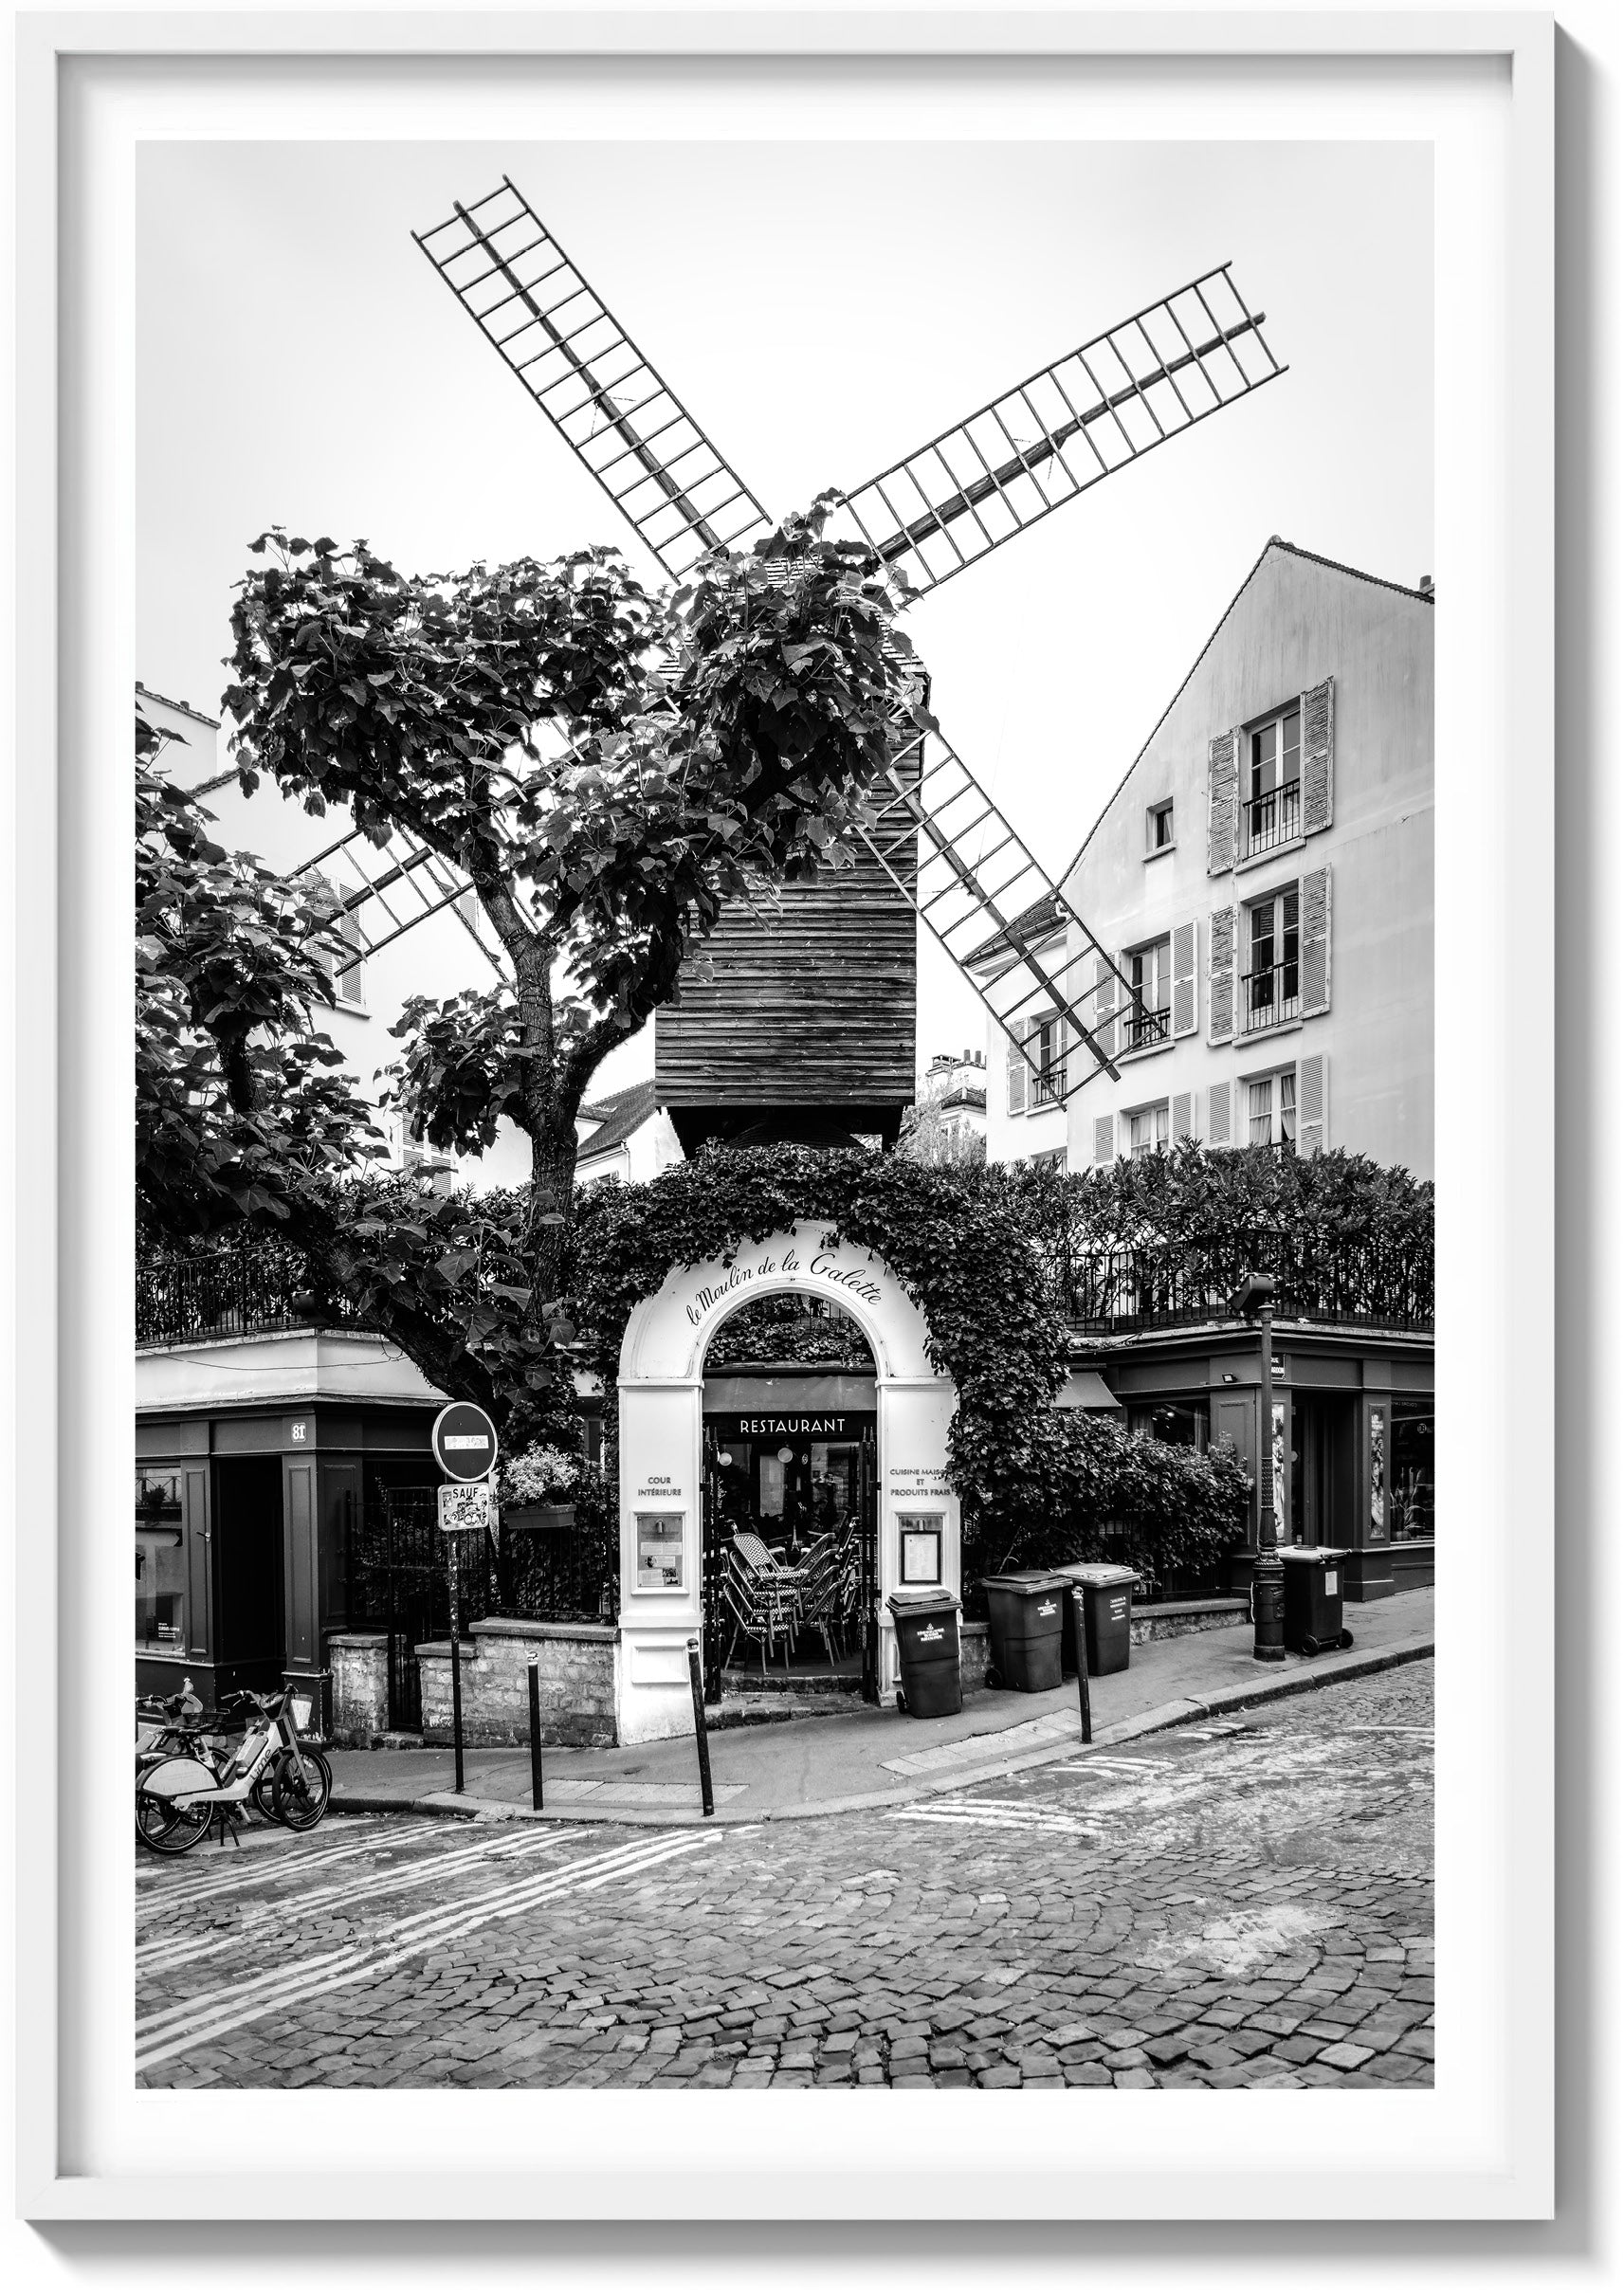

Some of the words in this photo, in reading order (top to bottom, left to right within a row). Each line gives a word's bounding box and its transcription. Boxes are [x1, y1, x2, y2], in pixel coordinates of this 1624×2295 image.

[686, 1304, 702, 1326] le
[696, 1266, 754, 1311] Moulin
[757, 1256, 776, 1275] de
[780, 1248, 800, 1271] la
[810, 1252, 882, 1305] Galette
[739, 1418, 846, 1433] RESTAURANT
[648, 1476, 671, 1484] COUR
[452, 1487, 479, 1499] SAUF
[637, 1487, 682, 1497] INTÉRIEURE
